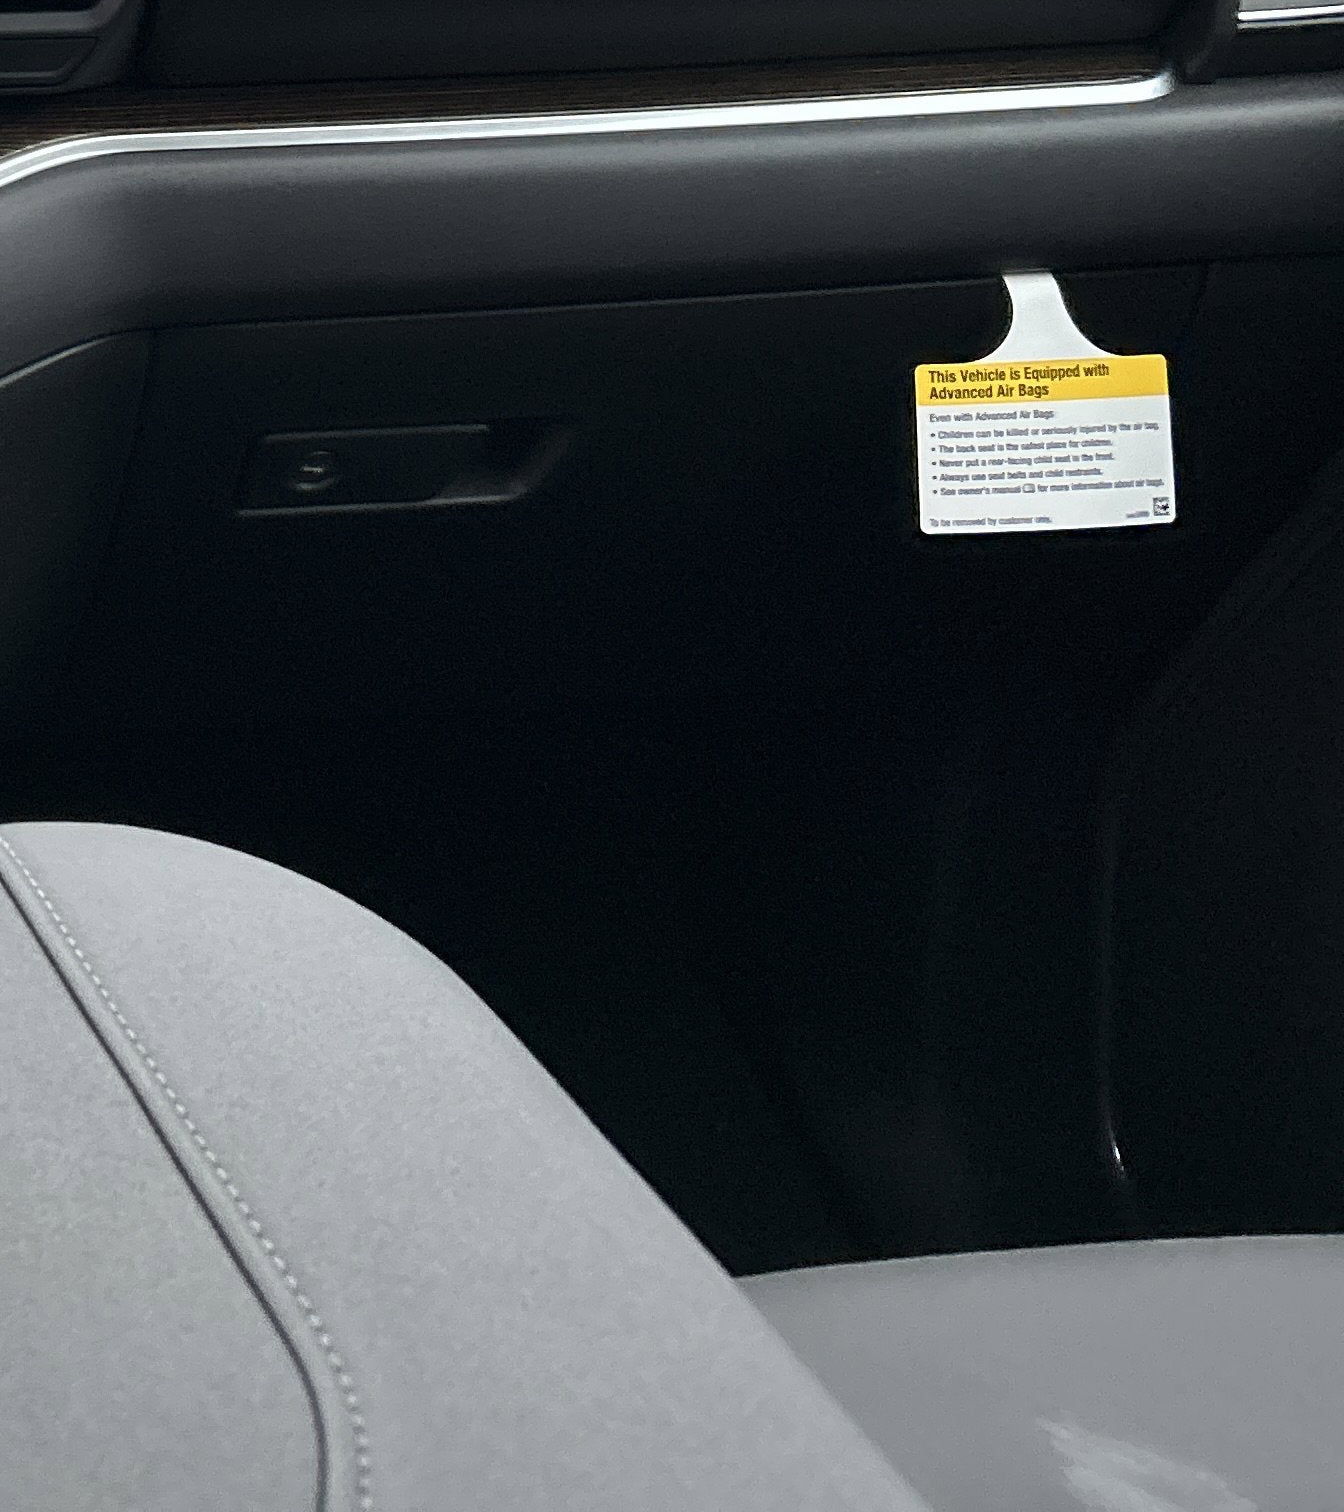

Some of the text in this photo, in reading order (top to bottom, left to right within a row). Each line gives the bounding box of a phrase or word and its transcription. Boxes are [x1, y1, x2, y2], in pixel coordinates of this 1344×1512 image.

[928, 364, 1110, 383] This Vehicle is Equipped with
[930, 384, 1050, 400] Advanced Air Bags
